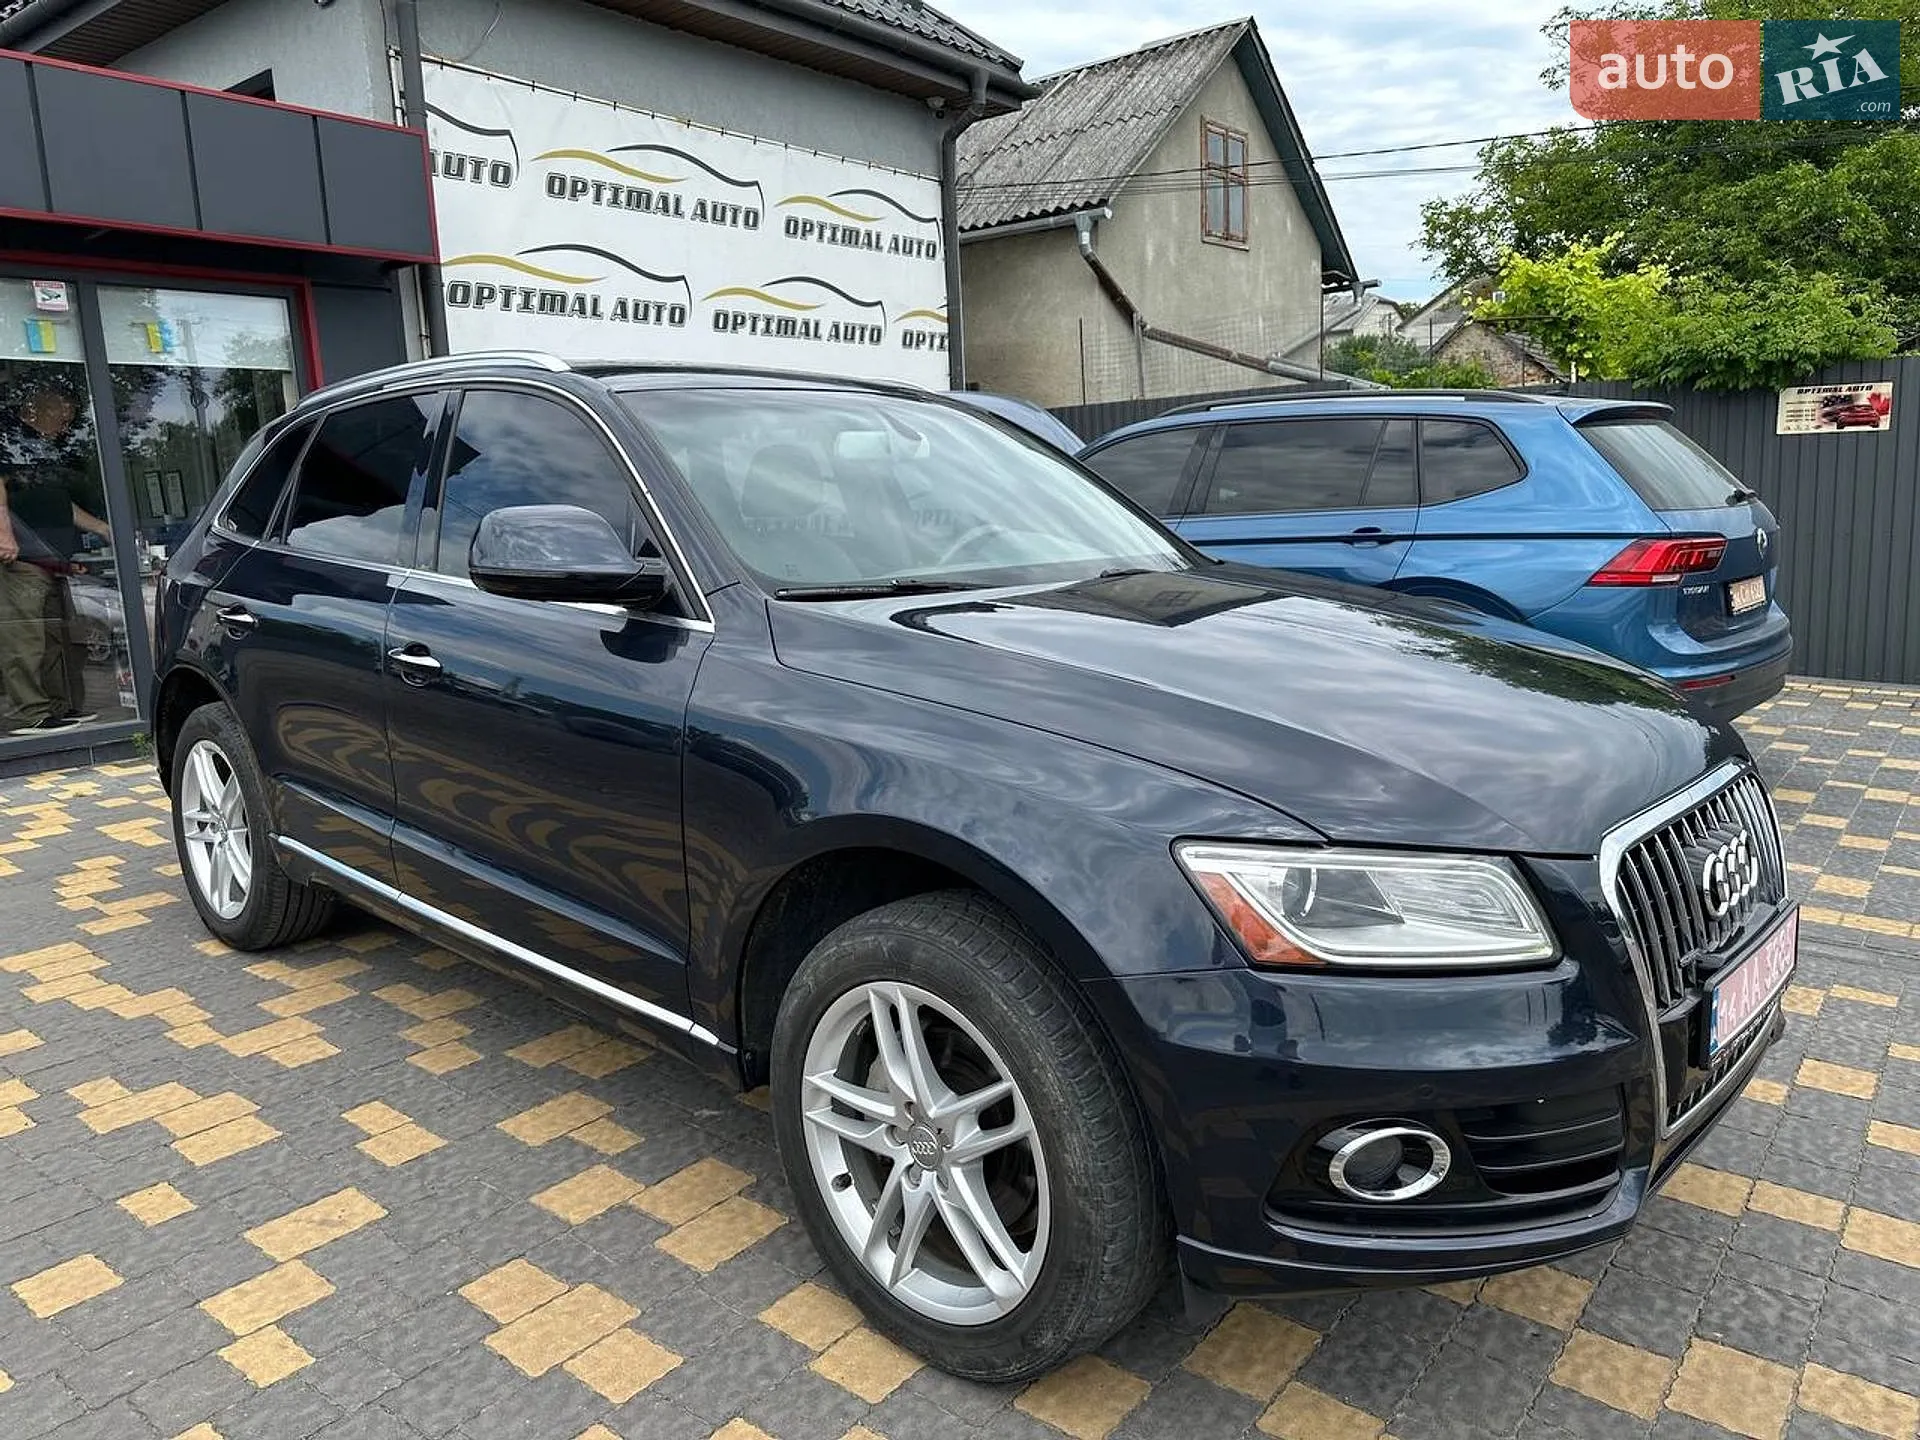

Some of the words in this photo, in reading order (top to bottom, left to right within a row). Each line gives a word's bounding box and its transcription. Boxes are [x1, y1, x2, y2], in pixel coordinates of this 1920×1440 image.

[546, 172, 685, 218] OPTIMAL
[690, 199, 760, 230] AUTO
[785, 215, 884, 251] OPTIMAL
[887, 233, 937, 260] AUTO
[446, 280, 604, 320] OPTIMAL
[610, 298, 688, 327] AUTO
[713, 310, 822, 340] OPTIMAL
[827, 321, 882, 345] AUTO
